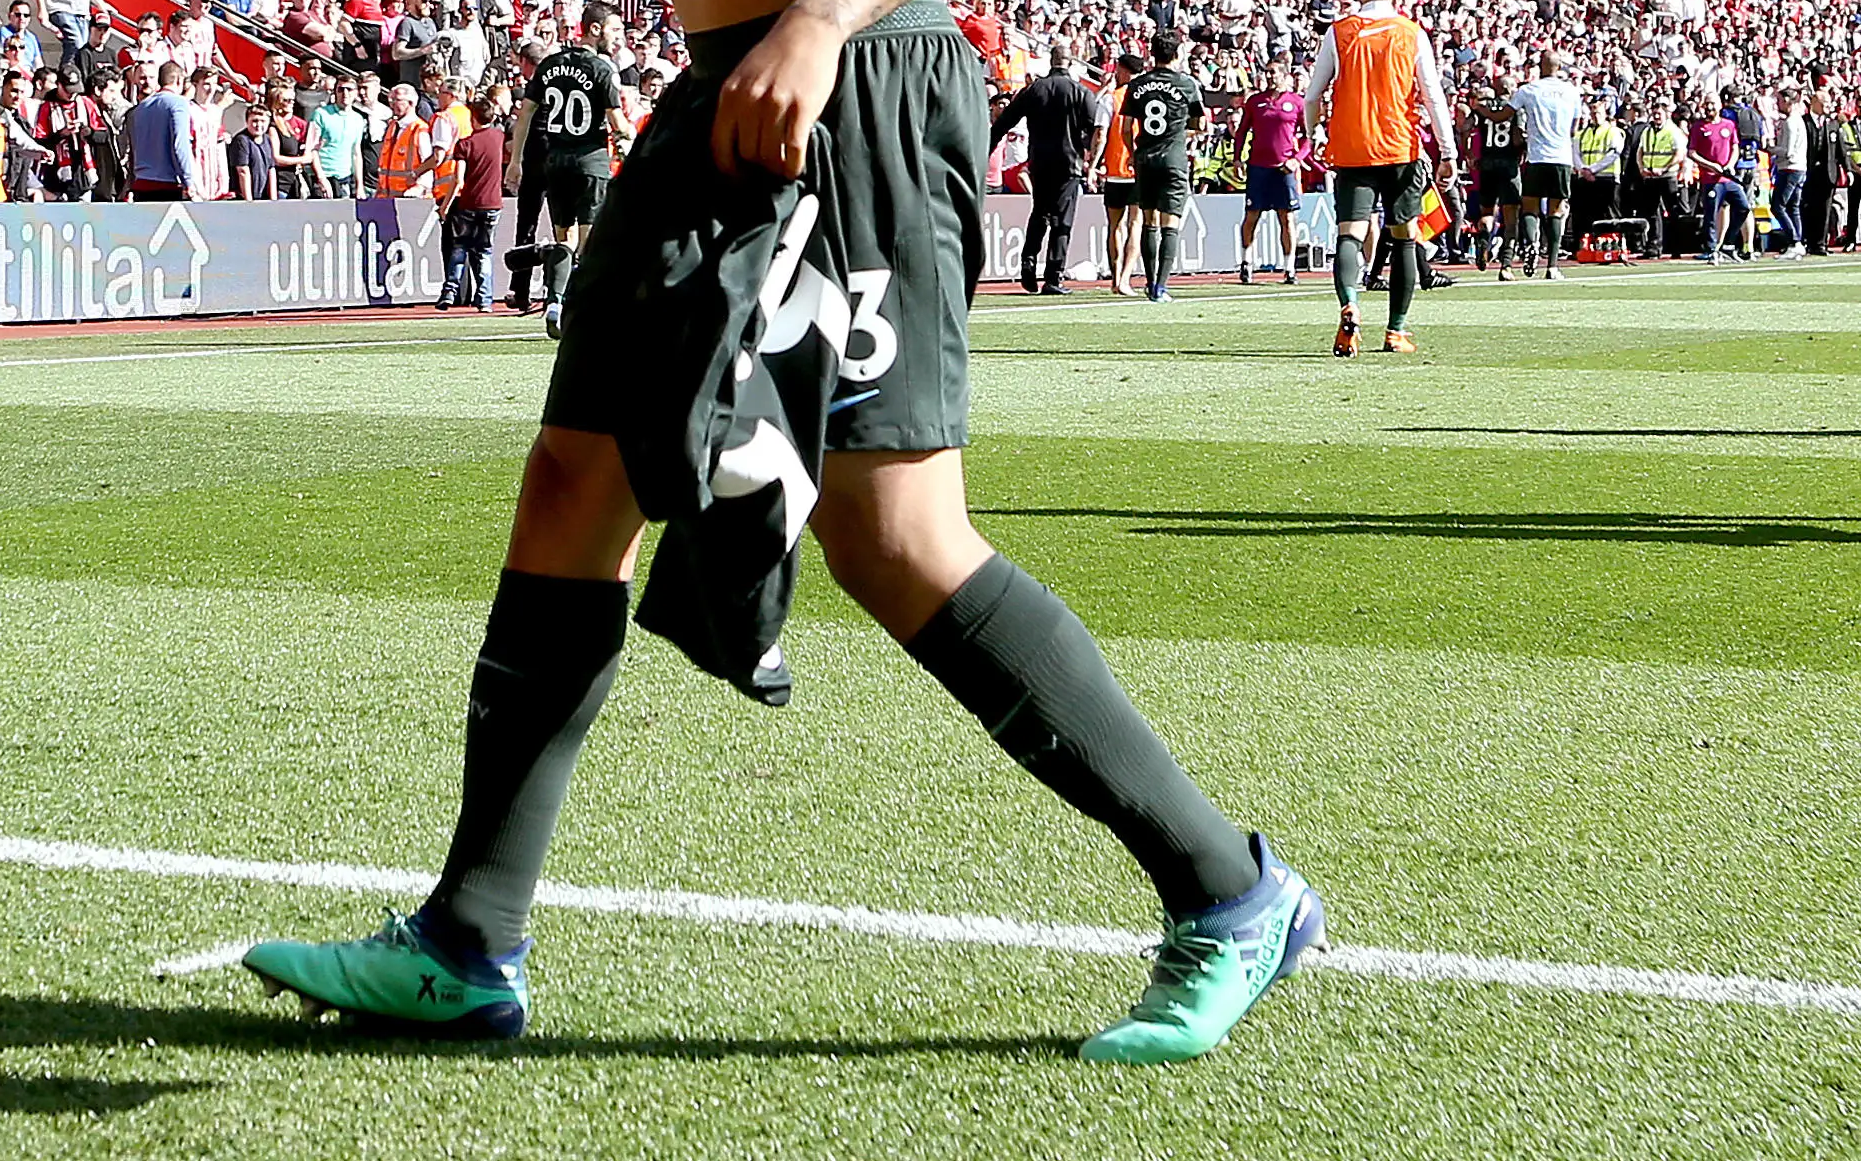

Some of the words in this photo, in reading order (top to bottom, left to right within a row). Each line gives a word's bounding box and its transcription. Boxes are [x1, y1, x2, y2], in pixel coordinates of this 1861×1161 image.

[542, 65, 594, 91] BERNARDO
[545, 86, 592, 136] 20
[1144, 99, 1168, 136] 8
[1484, 118, 1511, 148] 18
[269, 222, 415, 302] utilita
[1249, 918, 1284, 996] adidas
